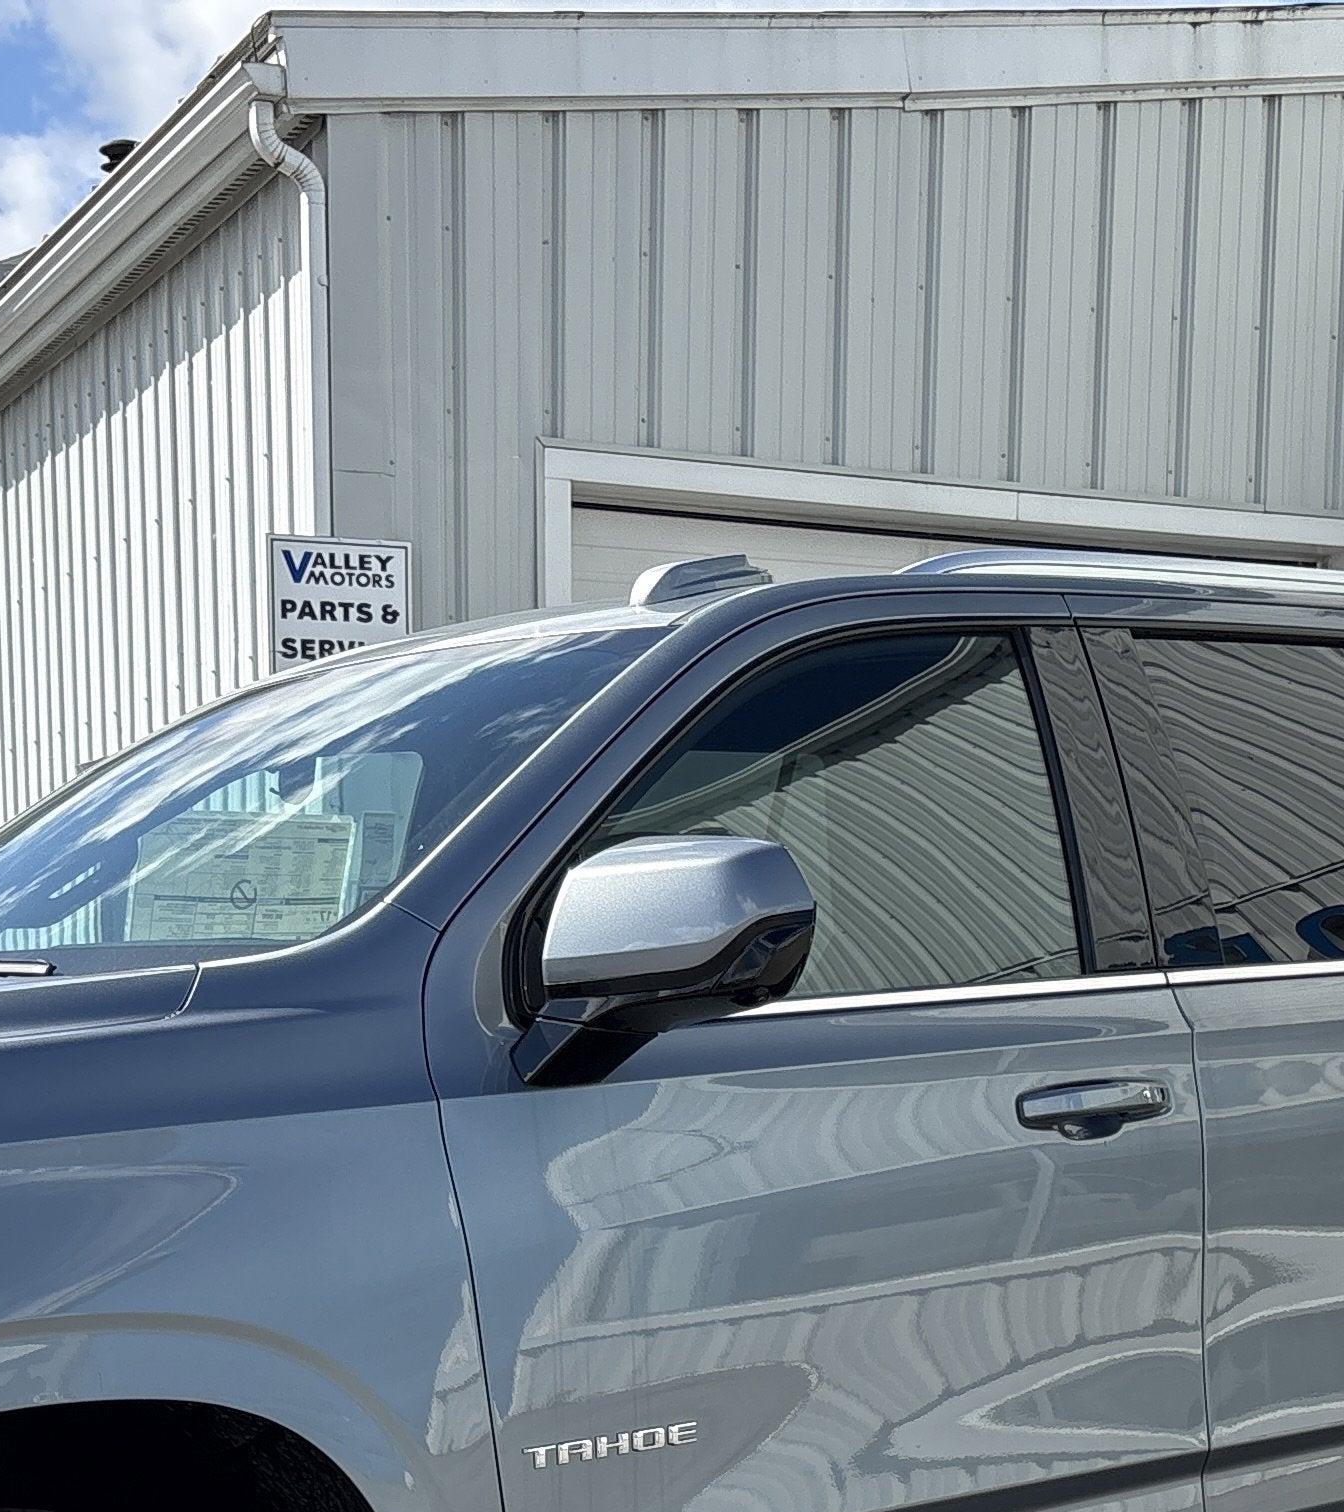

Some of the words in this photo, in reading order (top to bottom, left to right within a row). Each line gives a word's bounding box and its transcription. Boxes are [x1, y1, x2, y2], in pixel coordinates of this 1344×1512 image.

[281, 549, 395, 585] VALLEY
[305, 570, 396, 590] MOTORS
[280, 598, 374, 624] PARTS
[381, 603, 400, 625] &
[280, 636, 366, 662] SERV
[522, 1420, 698, 1469] TAHOE
